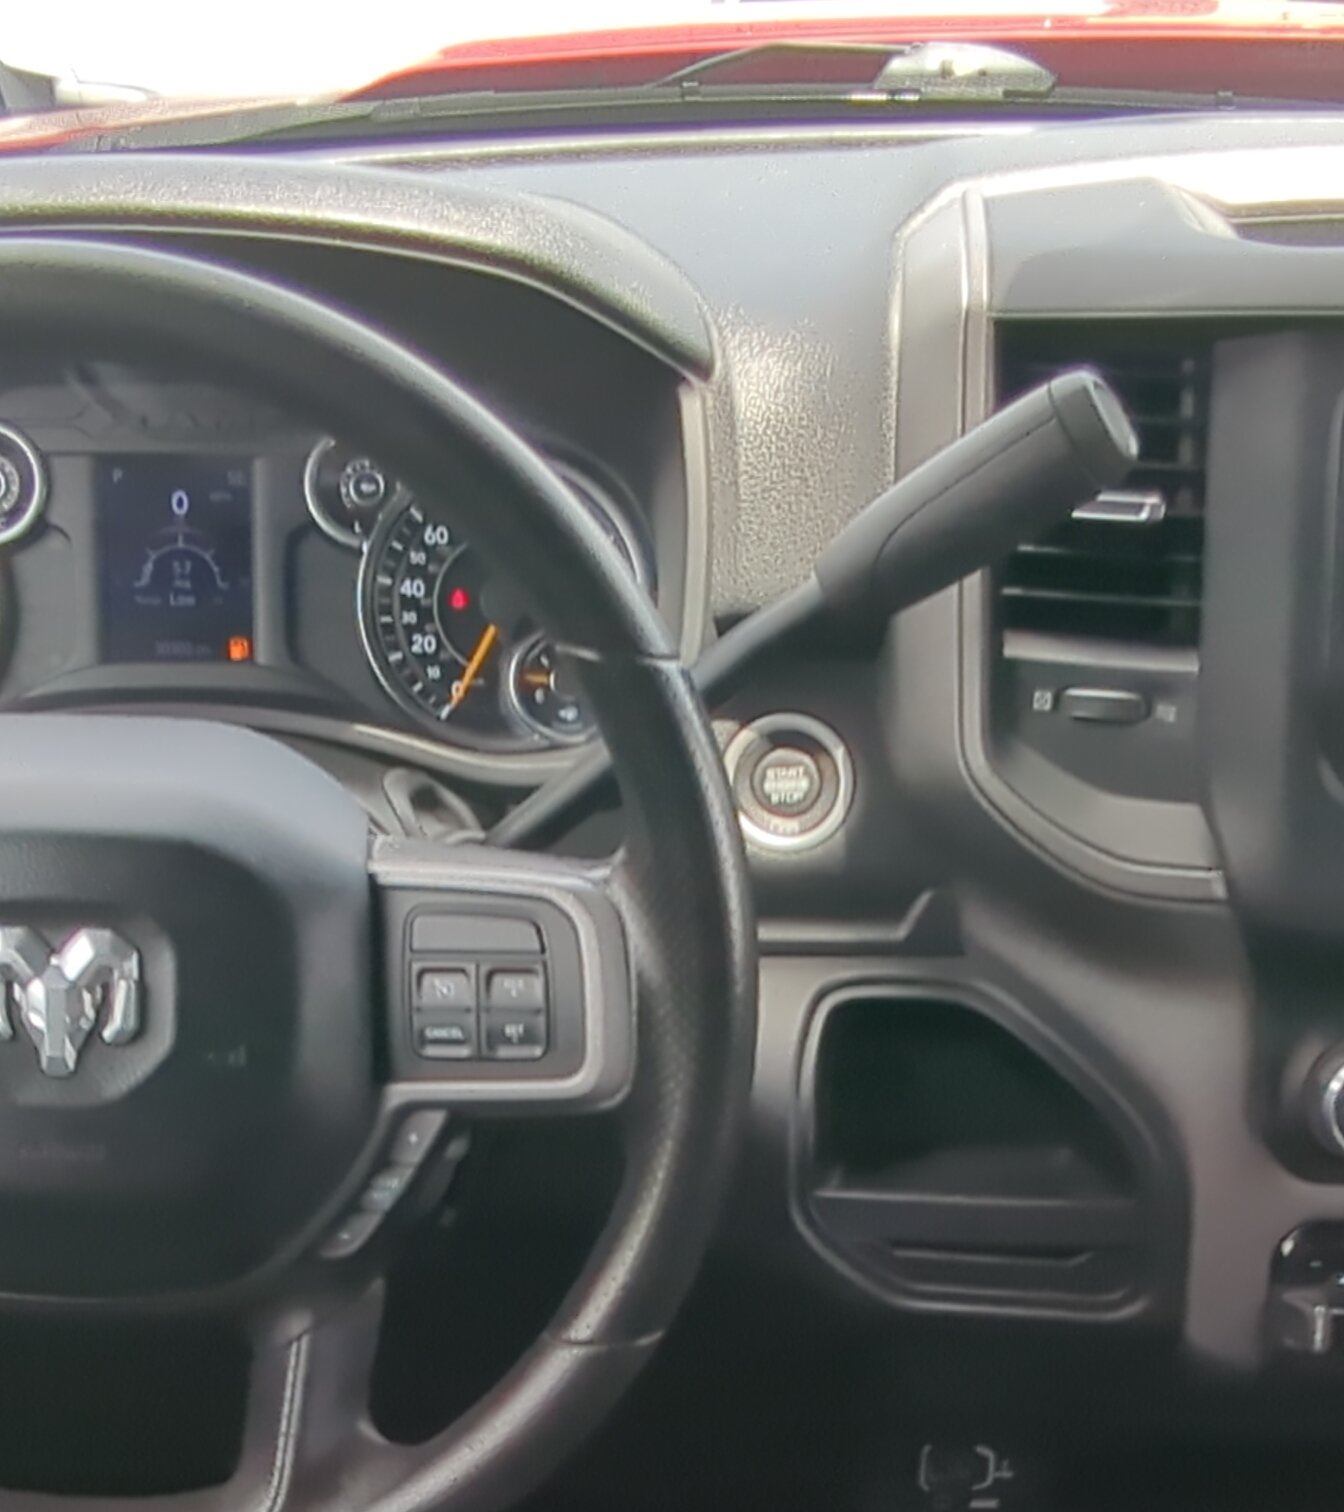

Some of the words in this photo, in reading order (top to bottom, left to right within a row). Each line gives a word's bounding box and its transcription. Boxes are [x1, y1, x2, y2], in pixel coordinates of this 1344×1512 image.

[171, 489, 189, 516] 0
[424, 525, 449, 545] 60
[409, 551, 426, 566] 50
[400, 579, 425, 598] 40
[402, 611, 417, 624] 30
[411, 634, 436, 653] 20
[427, 666, 440, 678] 10
